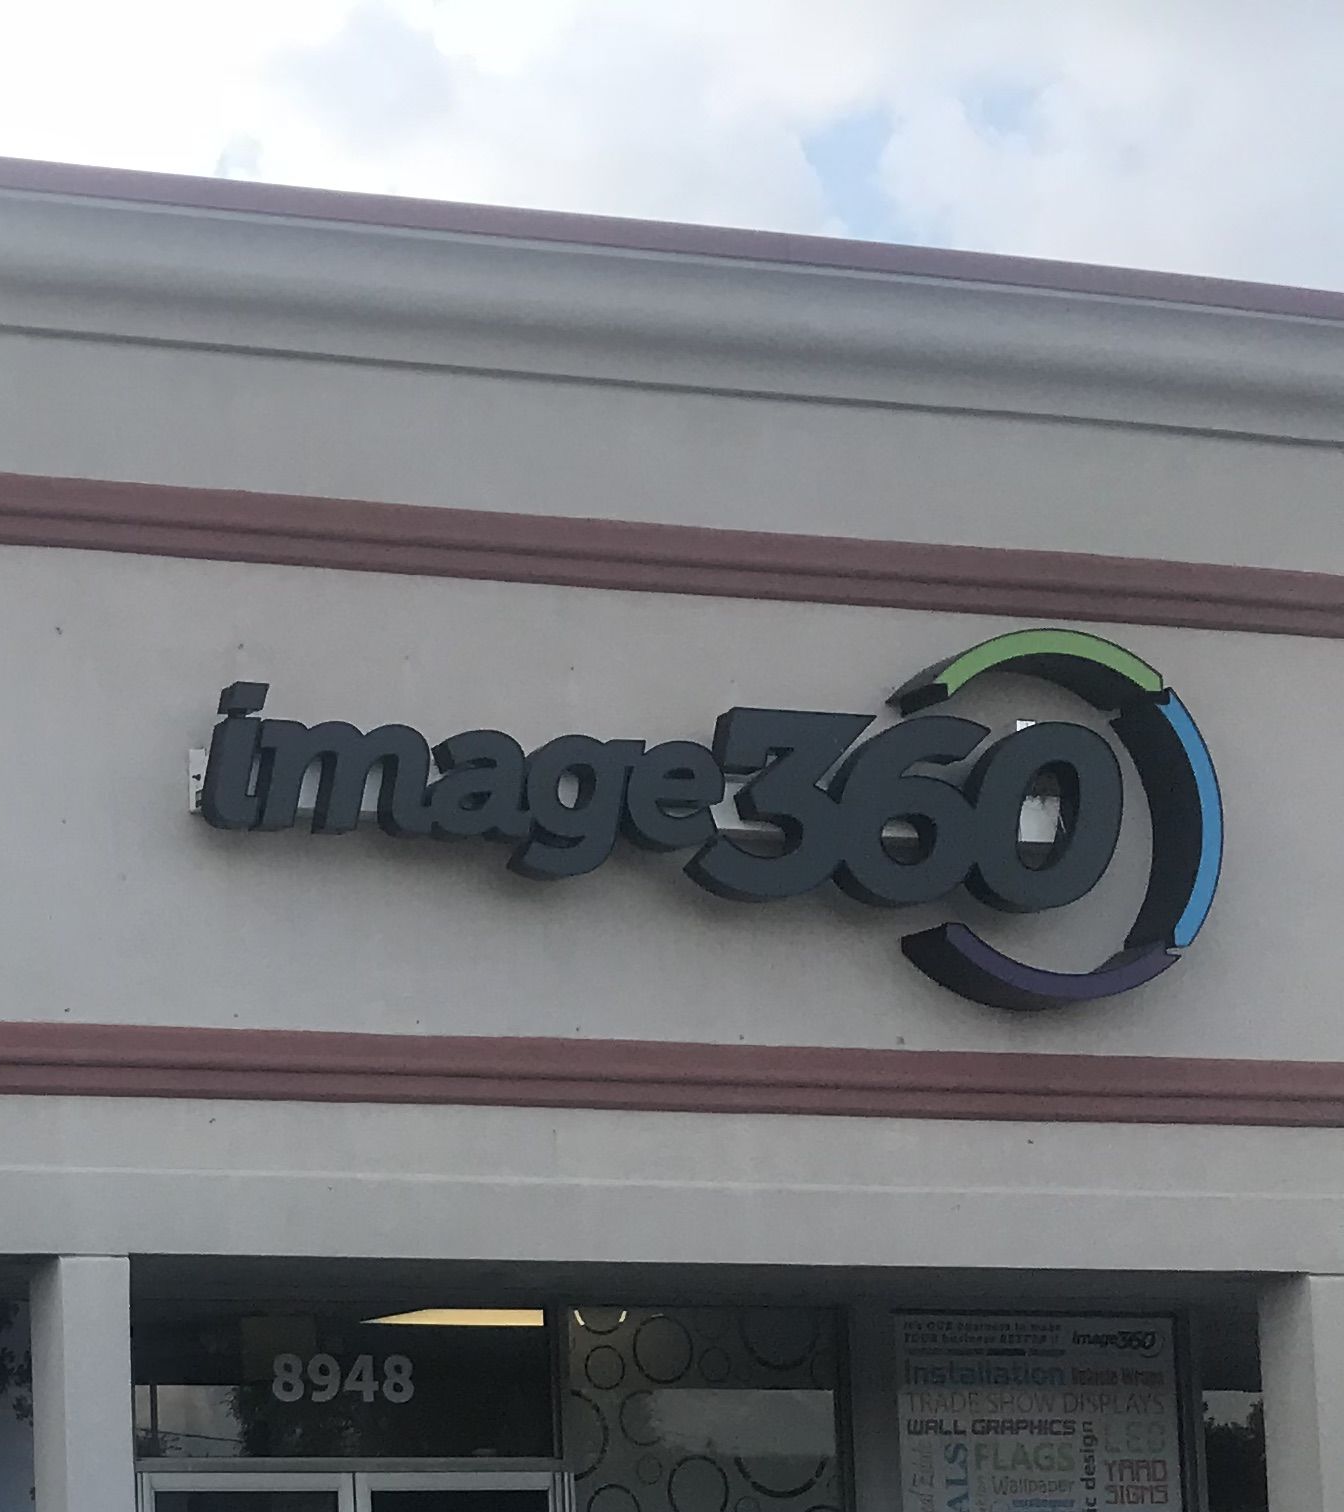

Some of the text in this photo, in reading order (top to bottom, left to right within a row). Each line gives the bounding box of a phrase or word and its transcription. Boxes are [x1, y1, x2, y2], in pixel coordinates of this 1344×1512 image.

[199, 682, 1123, 912] image360
[272, 1354, 414, 1403] 8948
[907, 1419, 1075, 1436] WALL GRAPHICS
[974, 1443, 1075, 1472] FLAGS
[1081, 1421, 1098, 1490] design
[1105, 1459, 1168, 1482] YARD
[1105, 1484, 1169, 1505] SIGNS
